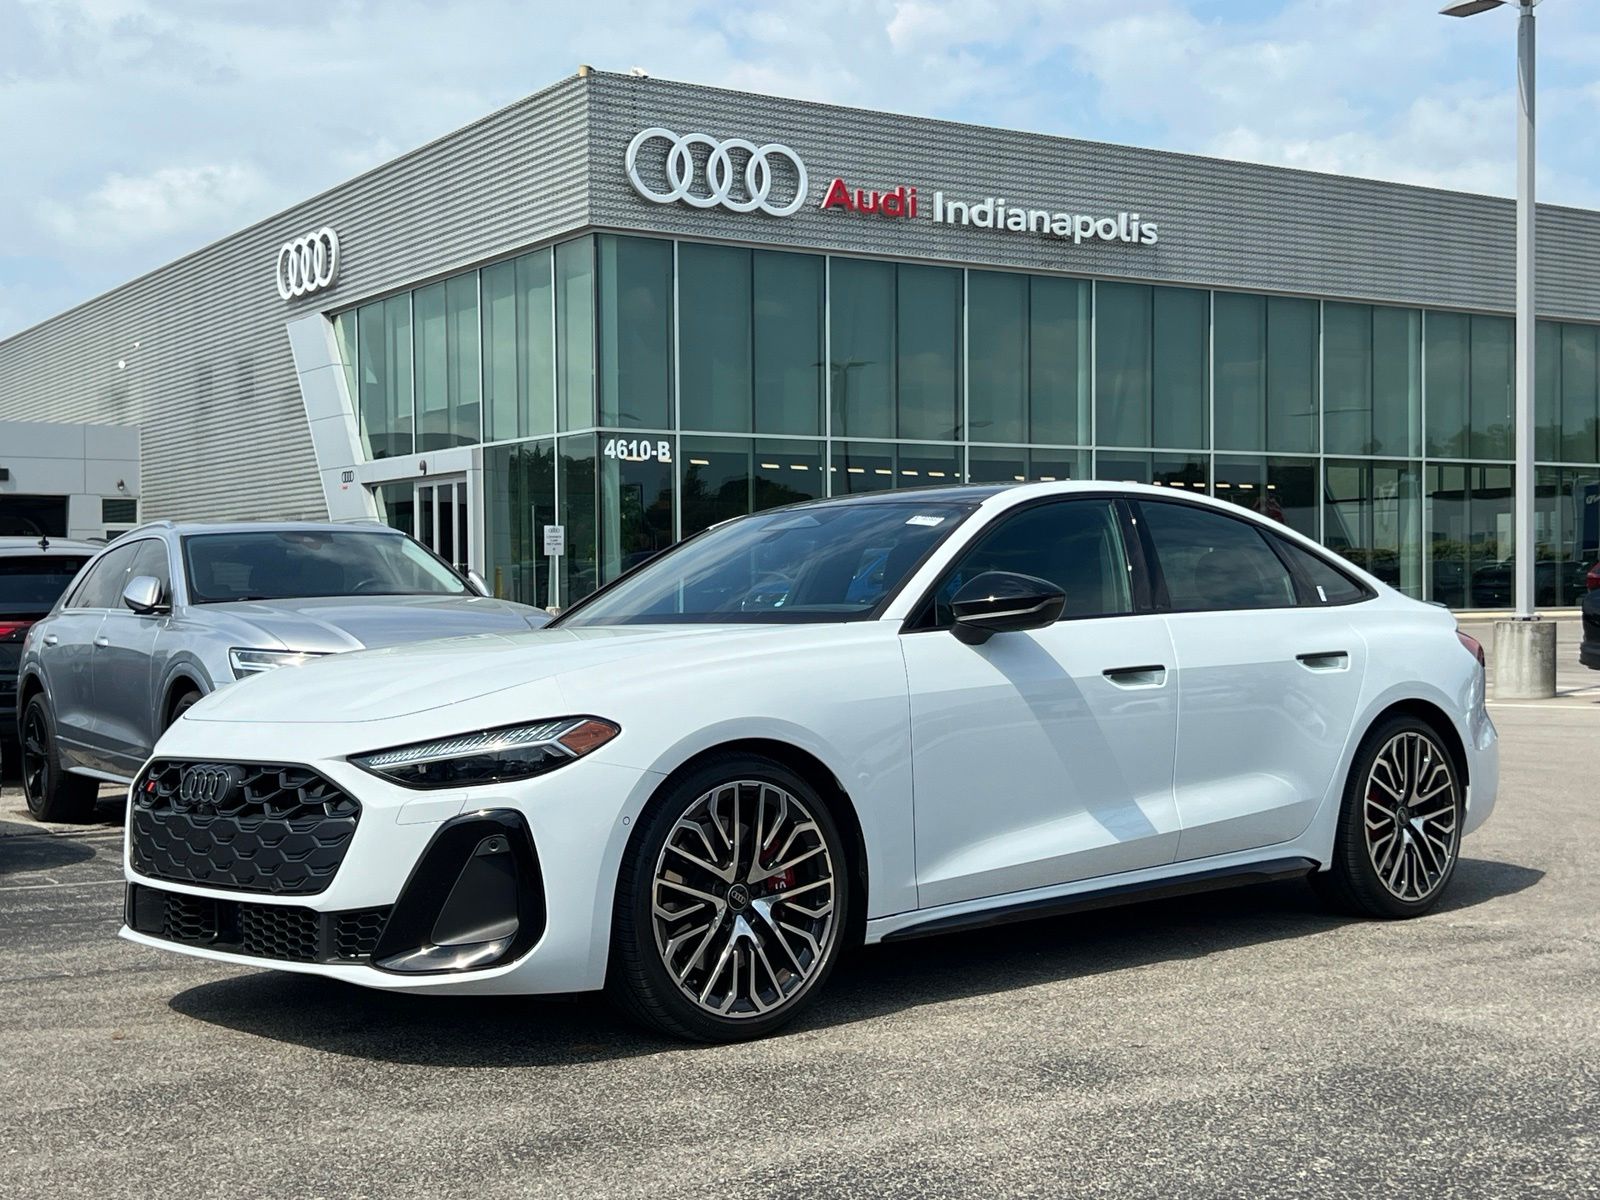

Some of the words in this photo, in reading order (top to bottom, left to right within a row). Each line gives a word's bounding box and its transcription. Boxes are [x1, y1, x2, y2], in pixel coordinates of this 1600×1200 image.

[820, 177, 918, 218] Audi
[933, 191, 1159, 245] Indianapolis
[604, 439, 671, 462] 4610-B
